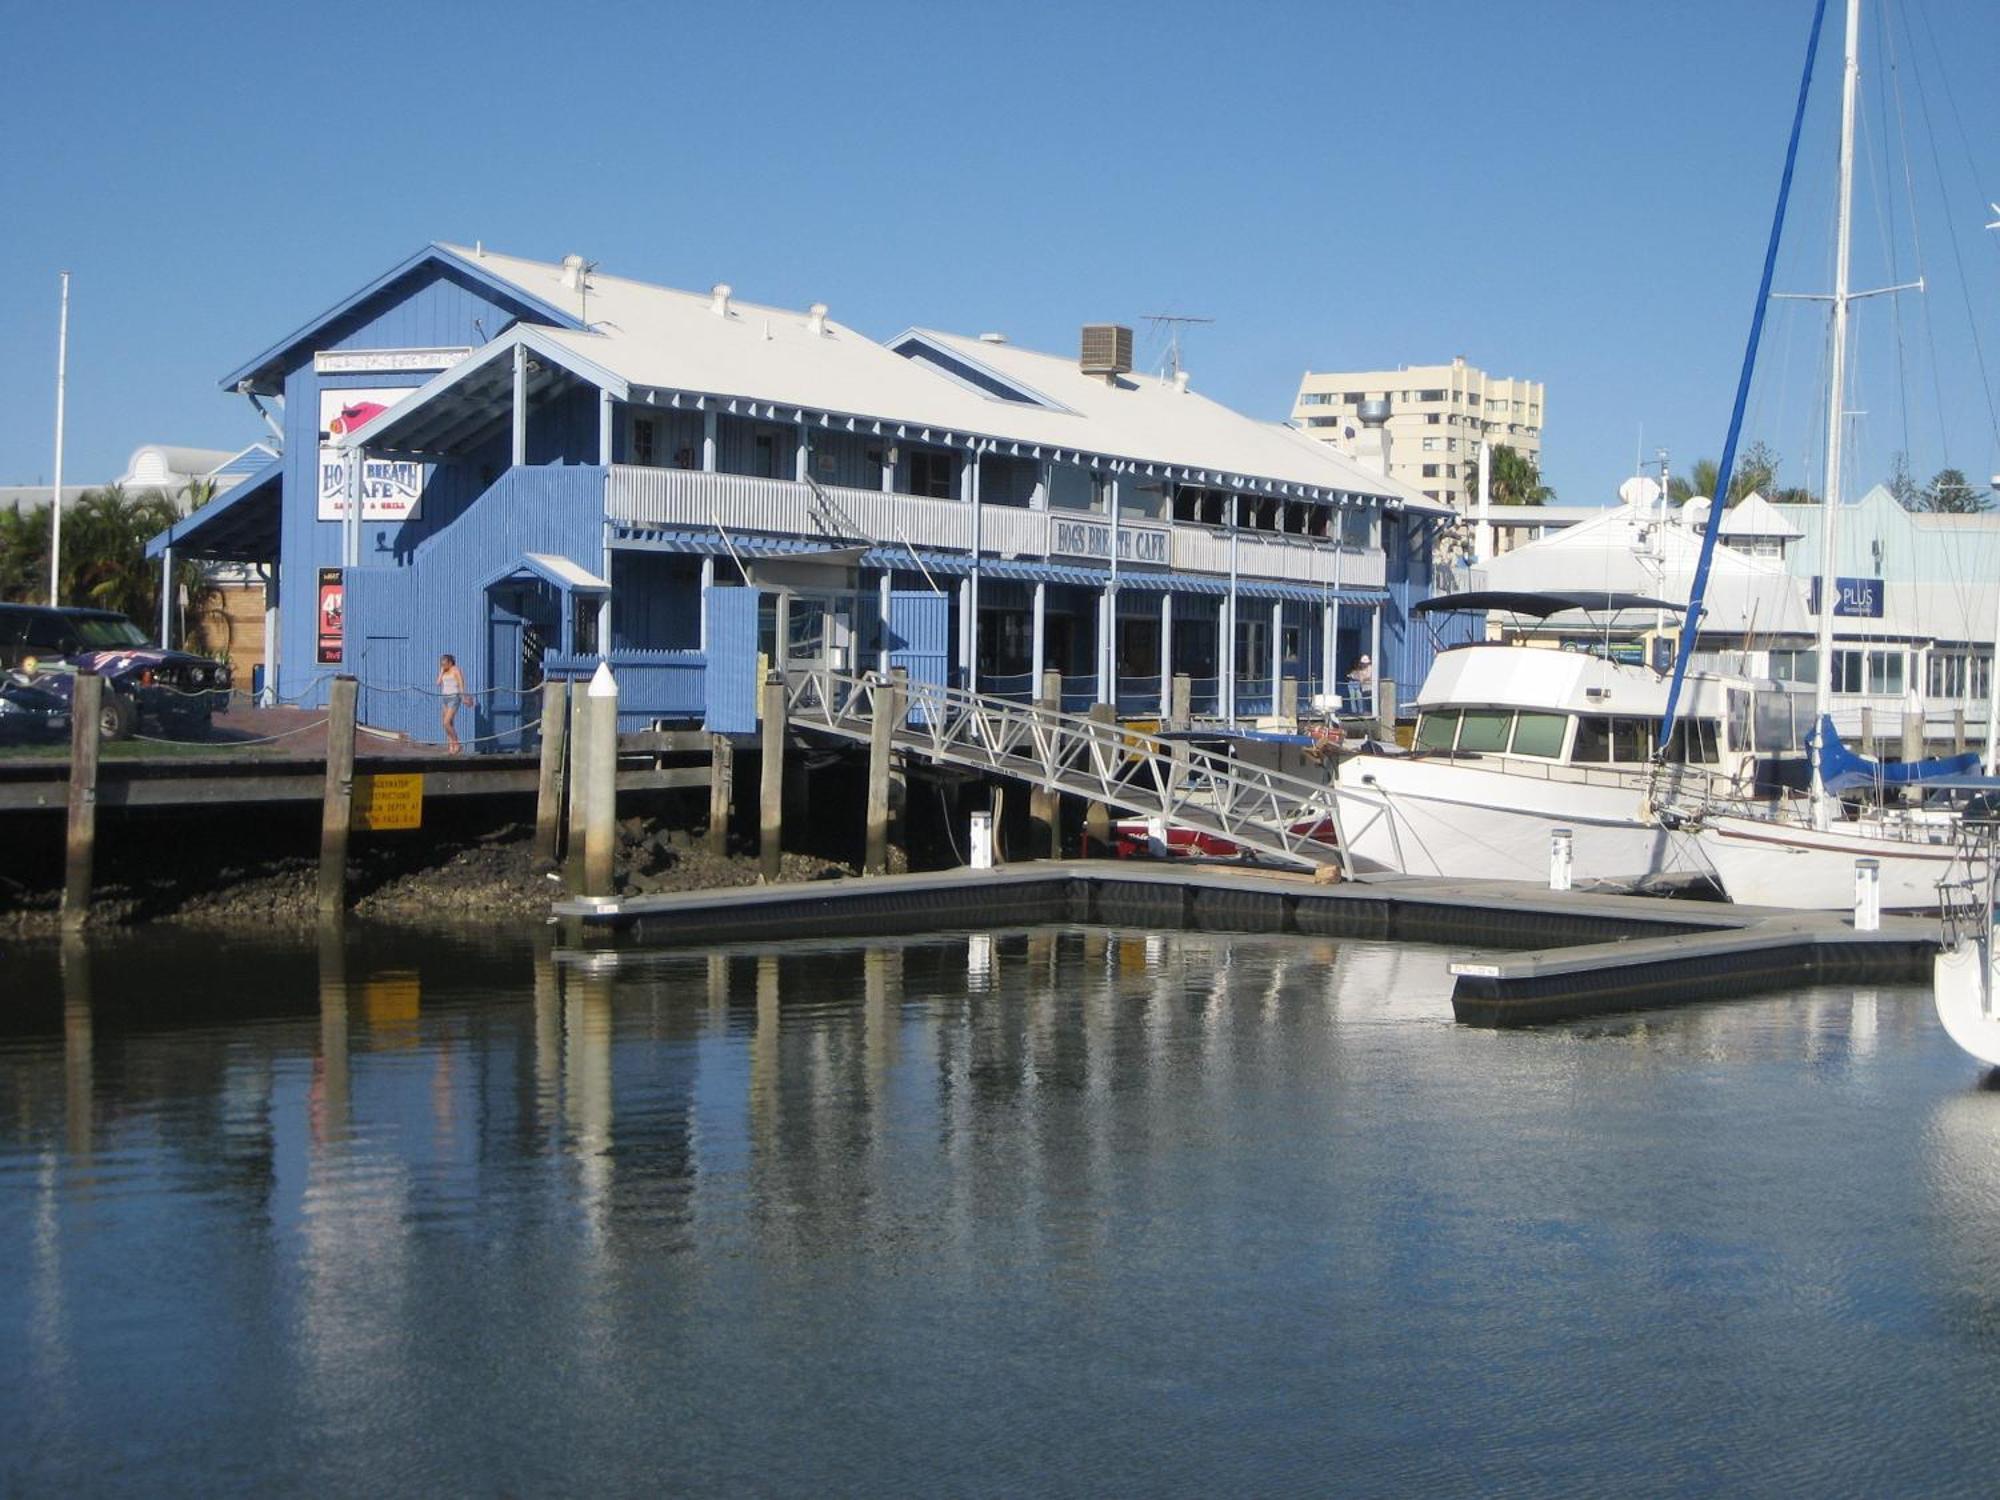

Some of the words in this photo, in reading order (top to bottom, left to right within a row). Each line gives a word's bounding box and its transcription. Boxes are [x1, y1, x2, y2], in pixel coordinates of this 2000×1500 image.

[367, 463, 417, 491] BREATH
[1136, 532, 1165, 561] CAFE
[1844, 588, 1873, 605] PLUS
